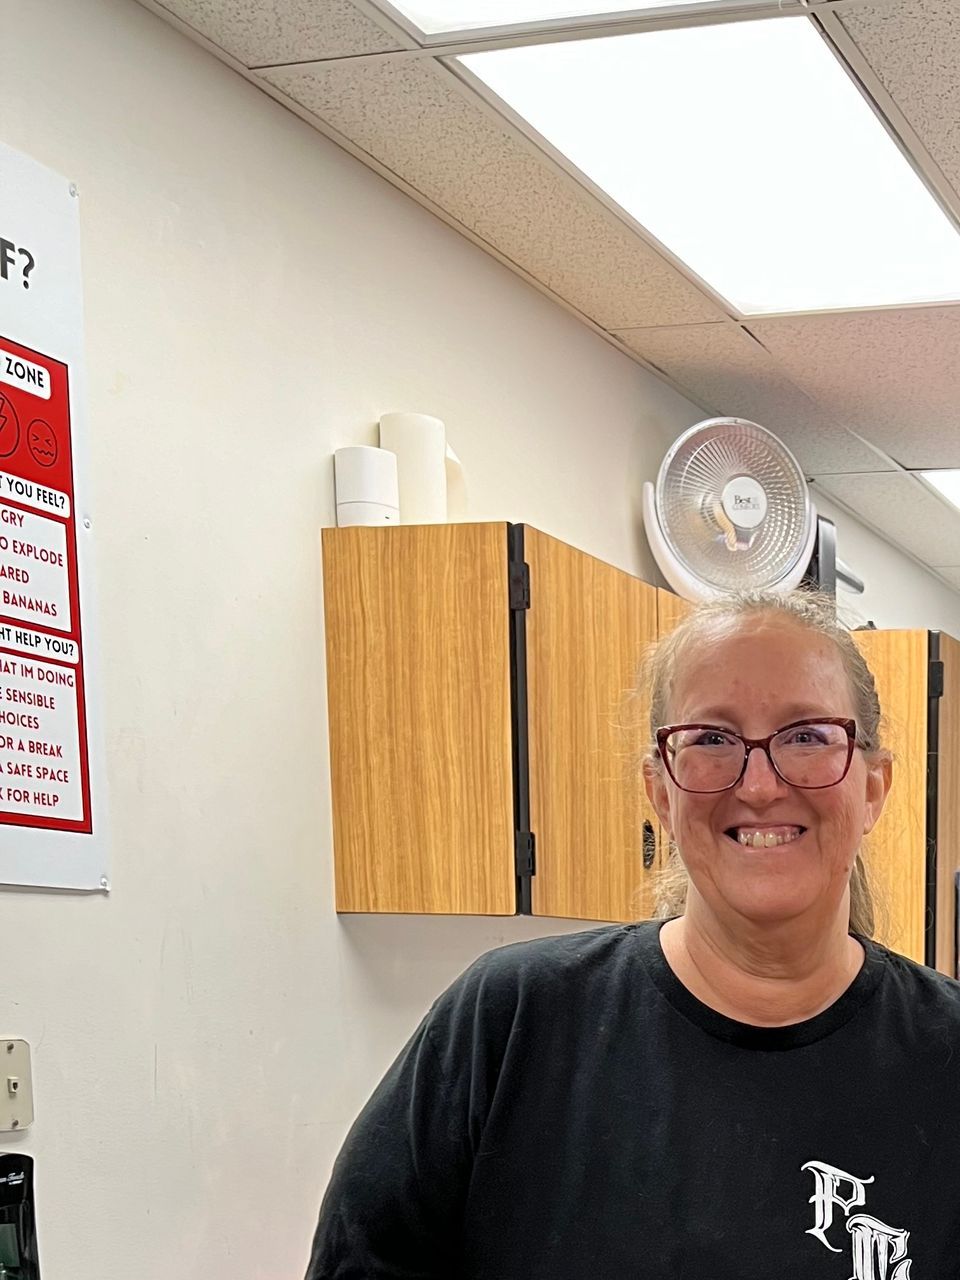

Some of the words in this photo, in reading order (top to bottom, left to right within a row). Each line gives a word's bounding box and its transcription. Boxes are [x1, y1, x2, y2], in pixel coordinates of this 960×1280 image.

[6, 356, 44, 388] ZONE
[7, 477, 33, 498] YOU
[36, 487, 65, 510] FEEL?
[12, 539, 64, 568] EXPLODE
[3, 590, 57, 617] BANANAS
[15, 630, 41, 649] HELP
[44, 637, 74, 657] YOU?
[21, 663, 34, 680] IM
[38, 668, 74, 688] DOING
[6, 687, 56, 710] SENSIBLE
[17, 738, 25, 752] A
[29, 740, 63, 758] BREAK
[7, 761, 33, 779] SAFE
[36, 766, 69, 783] SPACE
[7, 788, 30, 804] FOR
[33, 791, 59, 807] HELP
